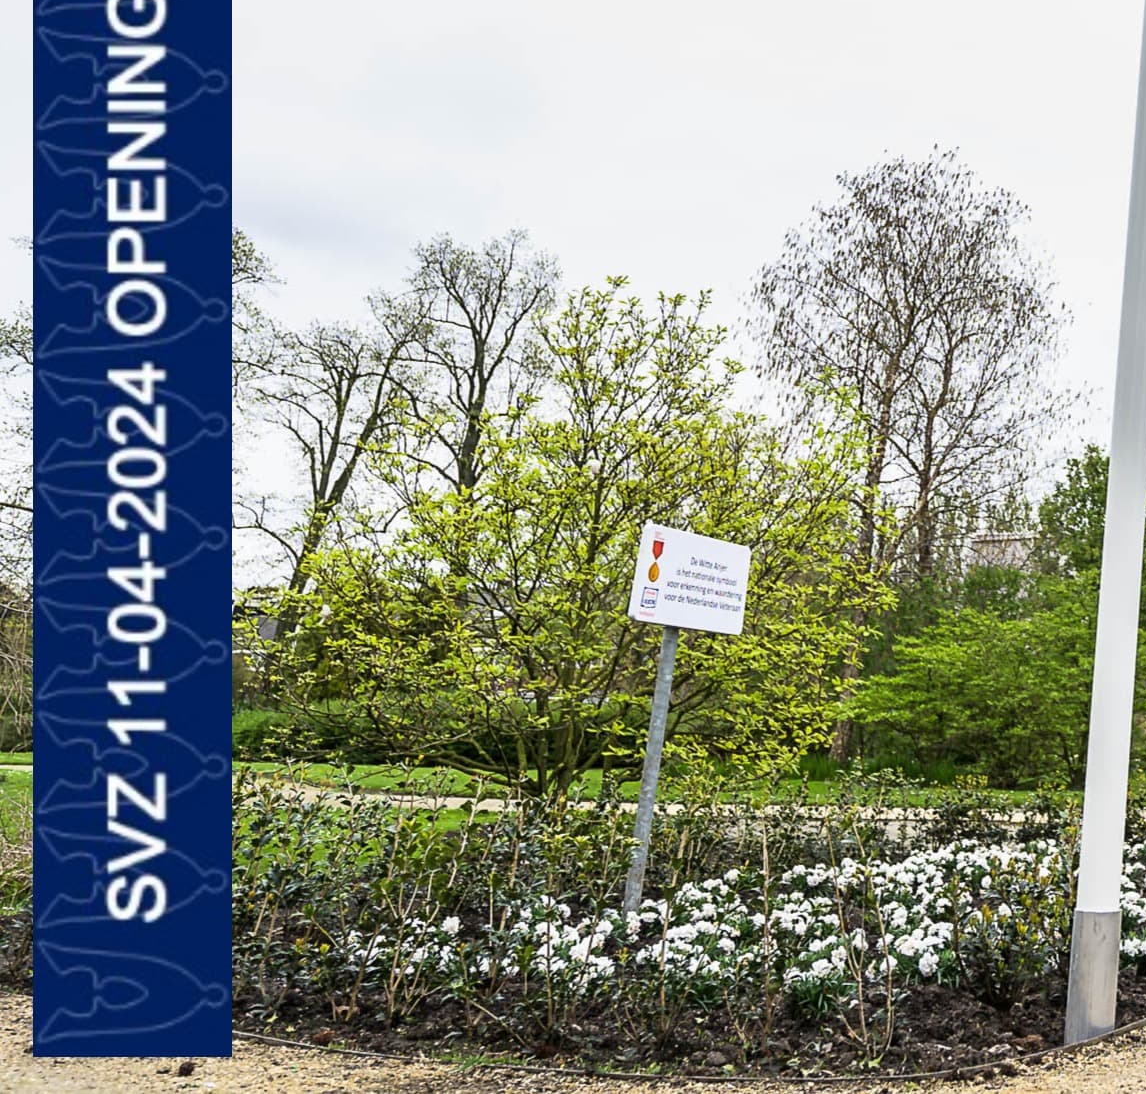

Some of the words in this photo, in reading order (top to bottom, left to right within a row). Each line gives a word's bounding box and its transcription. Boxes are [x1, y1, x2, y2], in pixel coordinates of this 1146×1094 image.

[667, 580, 680, 588] voor
[680, 582, 706, 596] erkenning
[665, 593, 677, 601] voor
[677, 594, 685, 603] de
